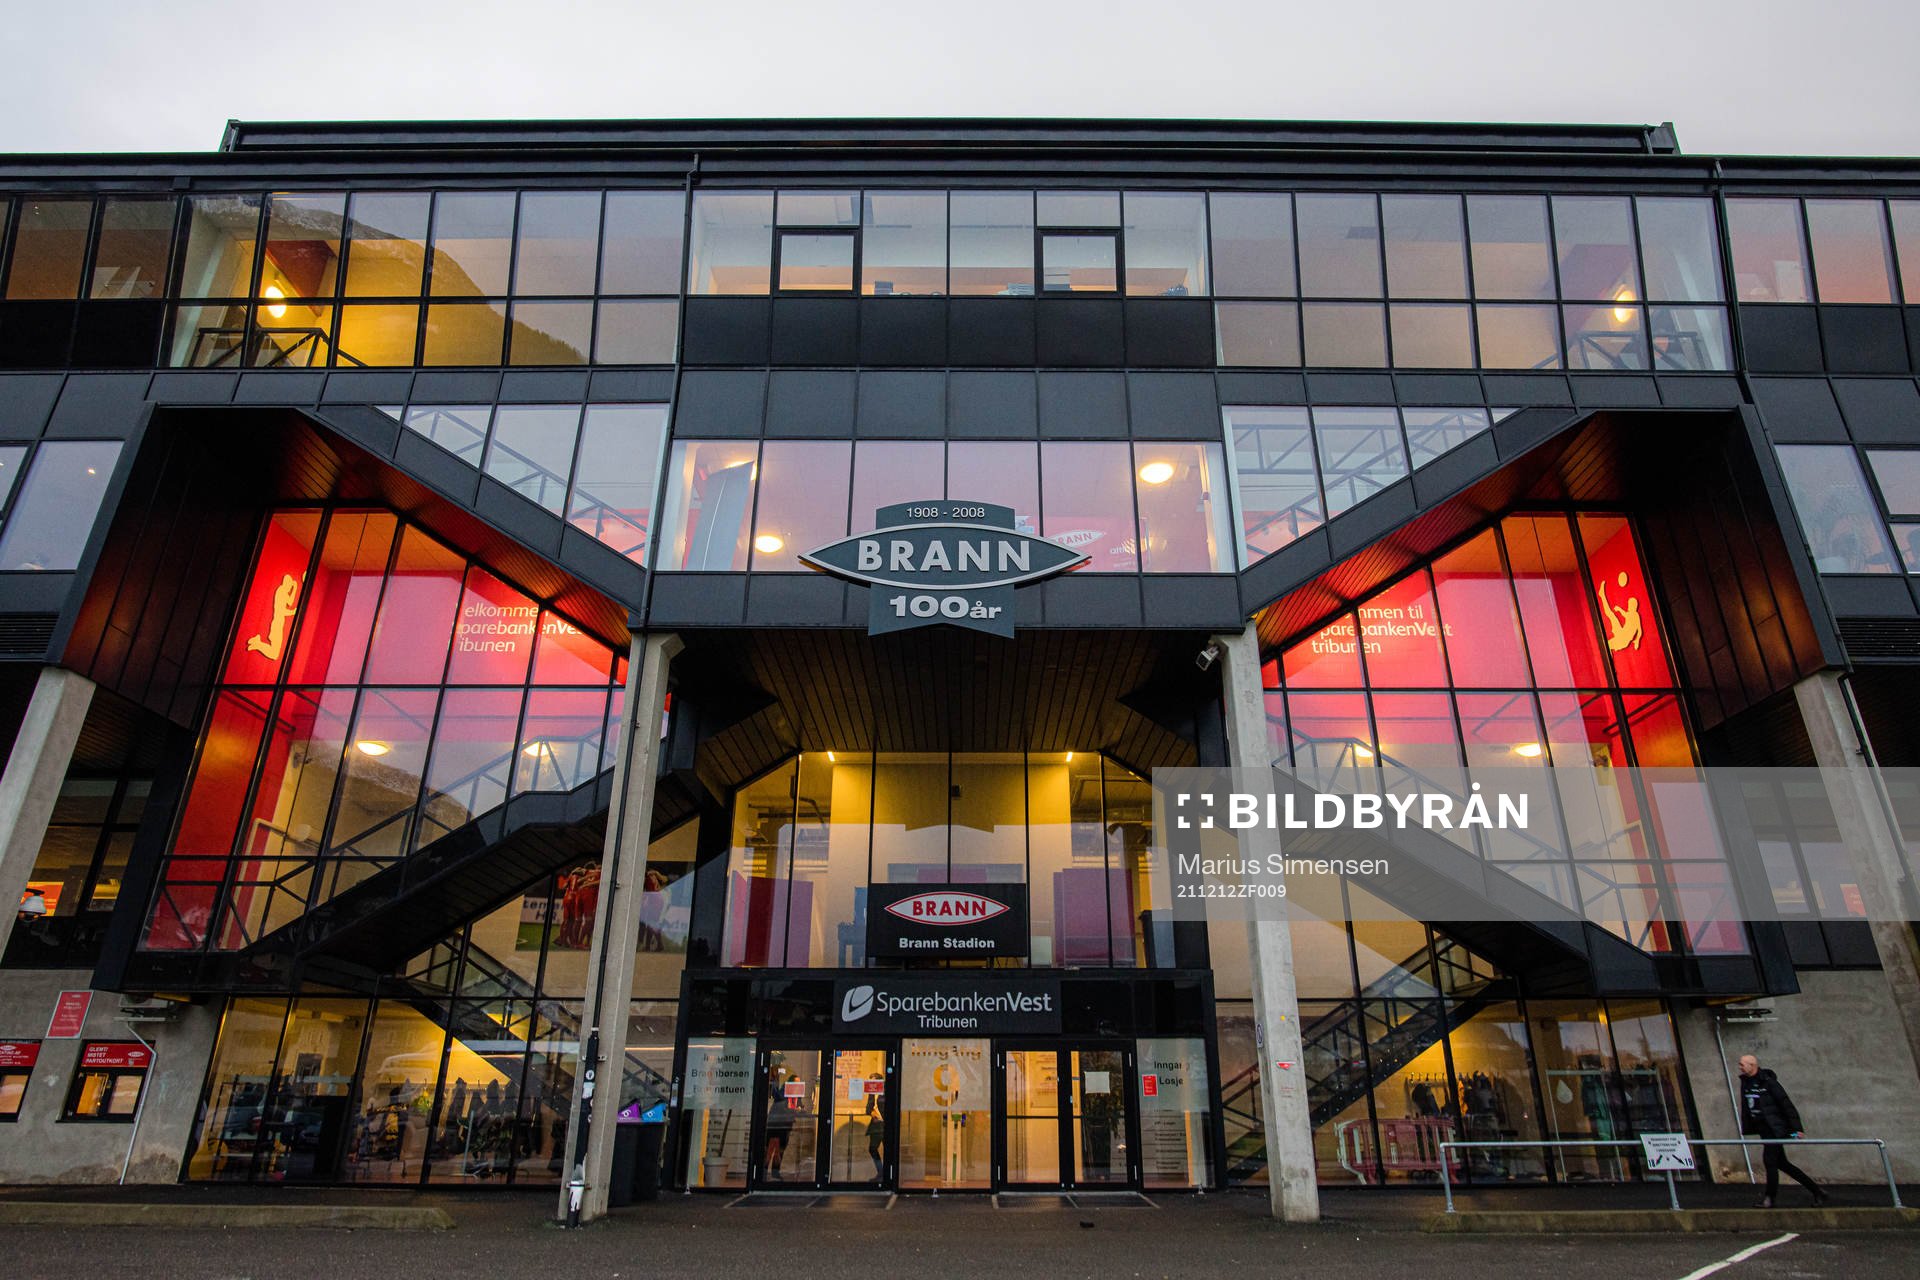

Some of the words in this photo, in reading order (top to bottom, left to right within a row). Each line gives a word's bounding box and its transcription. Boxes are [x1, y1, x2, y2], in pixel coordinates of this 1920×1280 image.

[906, 507, 939, 519] 1908
[952, 507, 986, 519] 2008
[1056, 532, 1094, 546] RANN
[857, 539, 1031, 572] BRANN
[455, 602, 549, 618] elkomme
[889, 595, 1003, 620] 100år
[1407, 605, 1424, 619] til
[1319, 621, 1454, 640] parebankenVet
[448, 637, 516, 653] ibunen
[911, 900, 987, 916] BRANN
[899, 937, 940, 949] Brann
[943, 937, 996, 949] Stadion
[876, 991, 1053, 1017] SparebankenVest
[917, 1014, 978, 1029] Tribunen
[932, 1063, 962, 1107] 9
